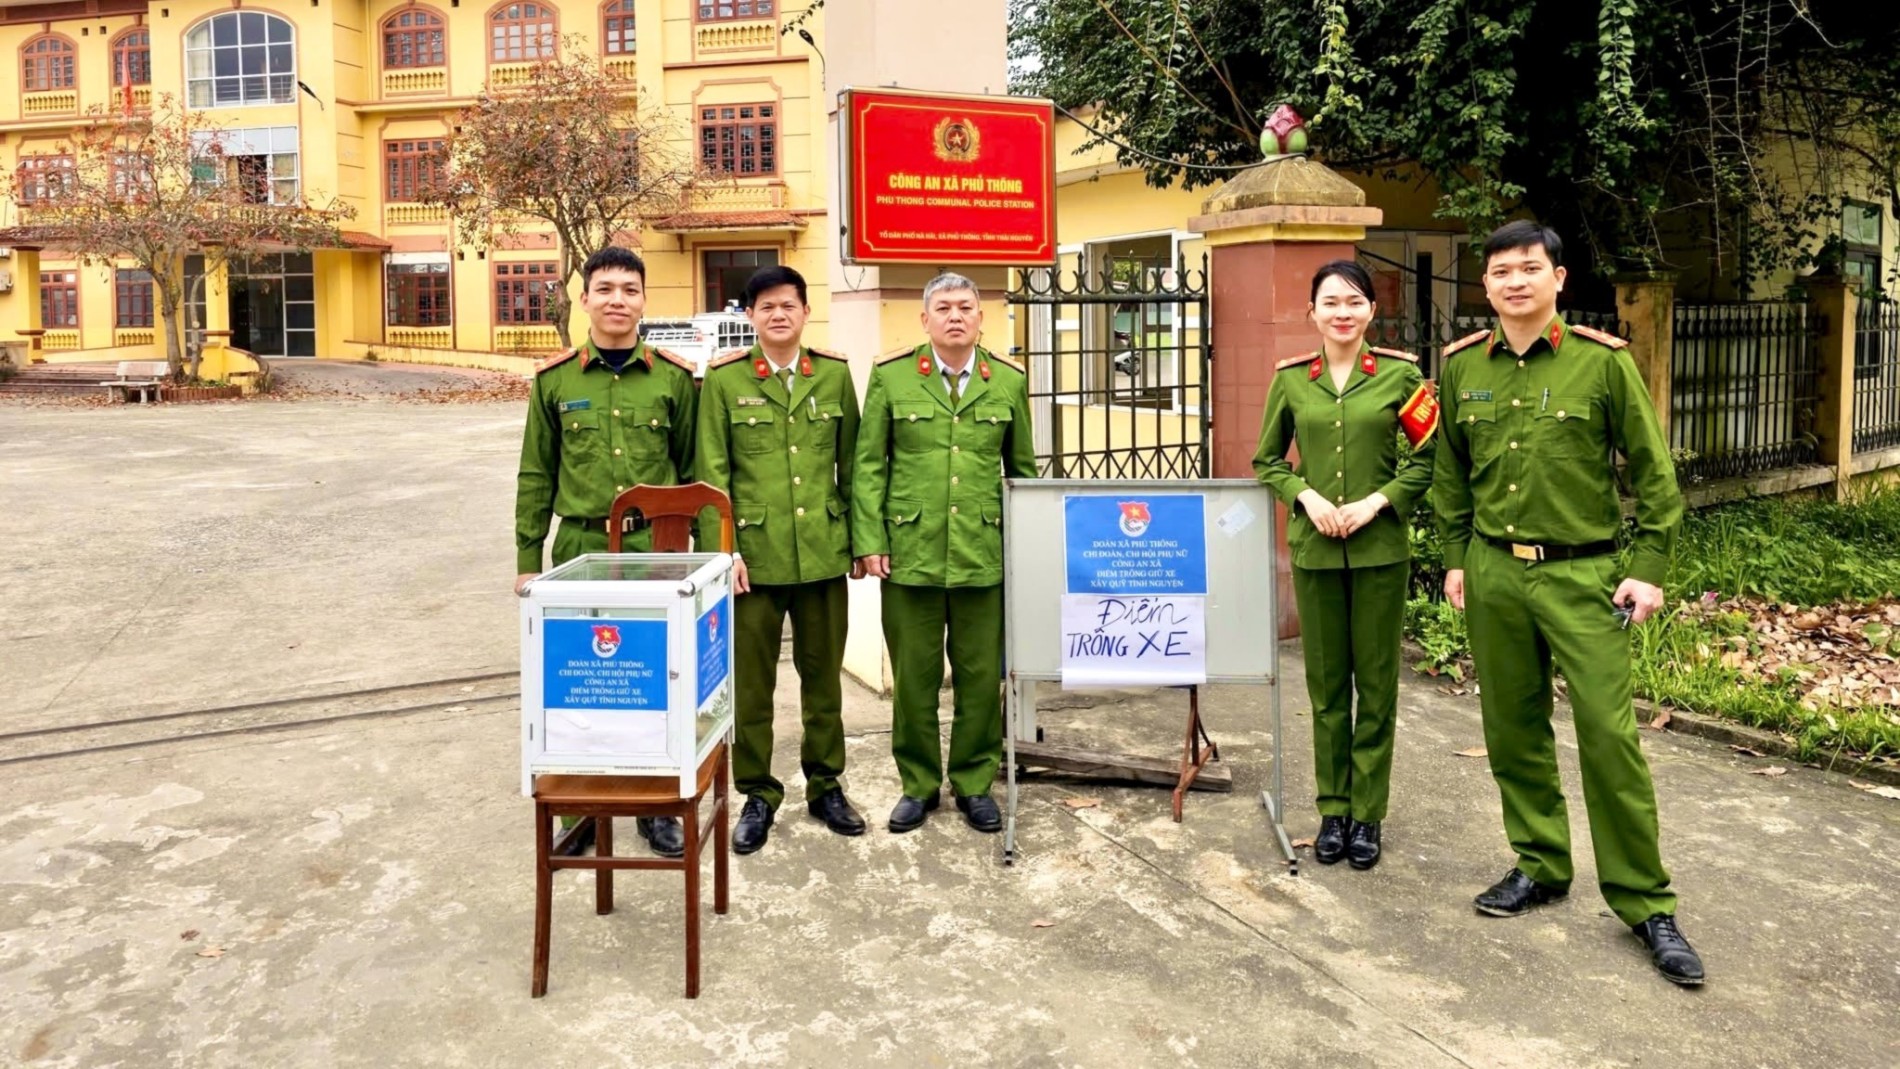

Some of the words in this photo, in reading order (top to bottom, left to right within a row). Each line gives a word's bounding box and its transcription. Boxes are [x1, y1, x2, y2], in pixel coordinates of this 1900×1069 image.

[889, 172, 921, 190] CÔNG
[924, 176, 940, 190] AN
[942, 175, 958, 190] XÃ
[962, 174, 984, 192] PHỦ
[986, 176, 1022, 193] THÔNG
[876, 196, 894, 204] PHU
[896, 196, 924, 206] THONG
[926, 197, 972, 207] COMMUNAL
[973, 199, 1002, 208] POLICE
[1004, 200, 1034, 208] STATION
[1093, 540, 1116, 548] ĐOÀN
[1118, 540, 1130, 548] XÃ
[1150, 539, 1178, 548] THÔNG
[1083, 550, 1098, 558] CHI
[1126, 550, 1140, 558] CHI
[1141, 550, 1156, 559] HỘI
[1158, 550, 1174, 559] PHỤ
[1150, 580, 1183, 588] NGUYỆN
[1097, 597, 1190, 629] Điểm
[1136, 630, 1191, 658] XE
[617, 696, 648, 705] NGUYỆN
